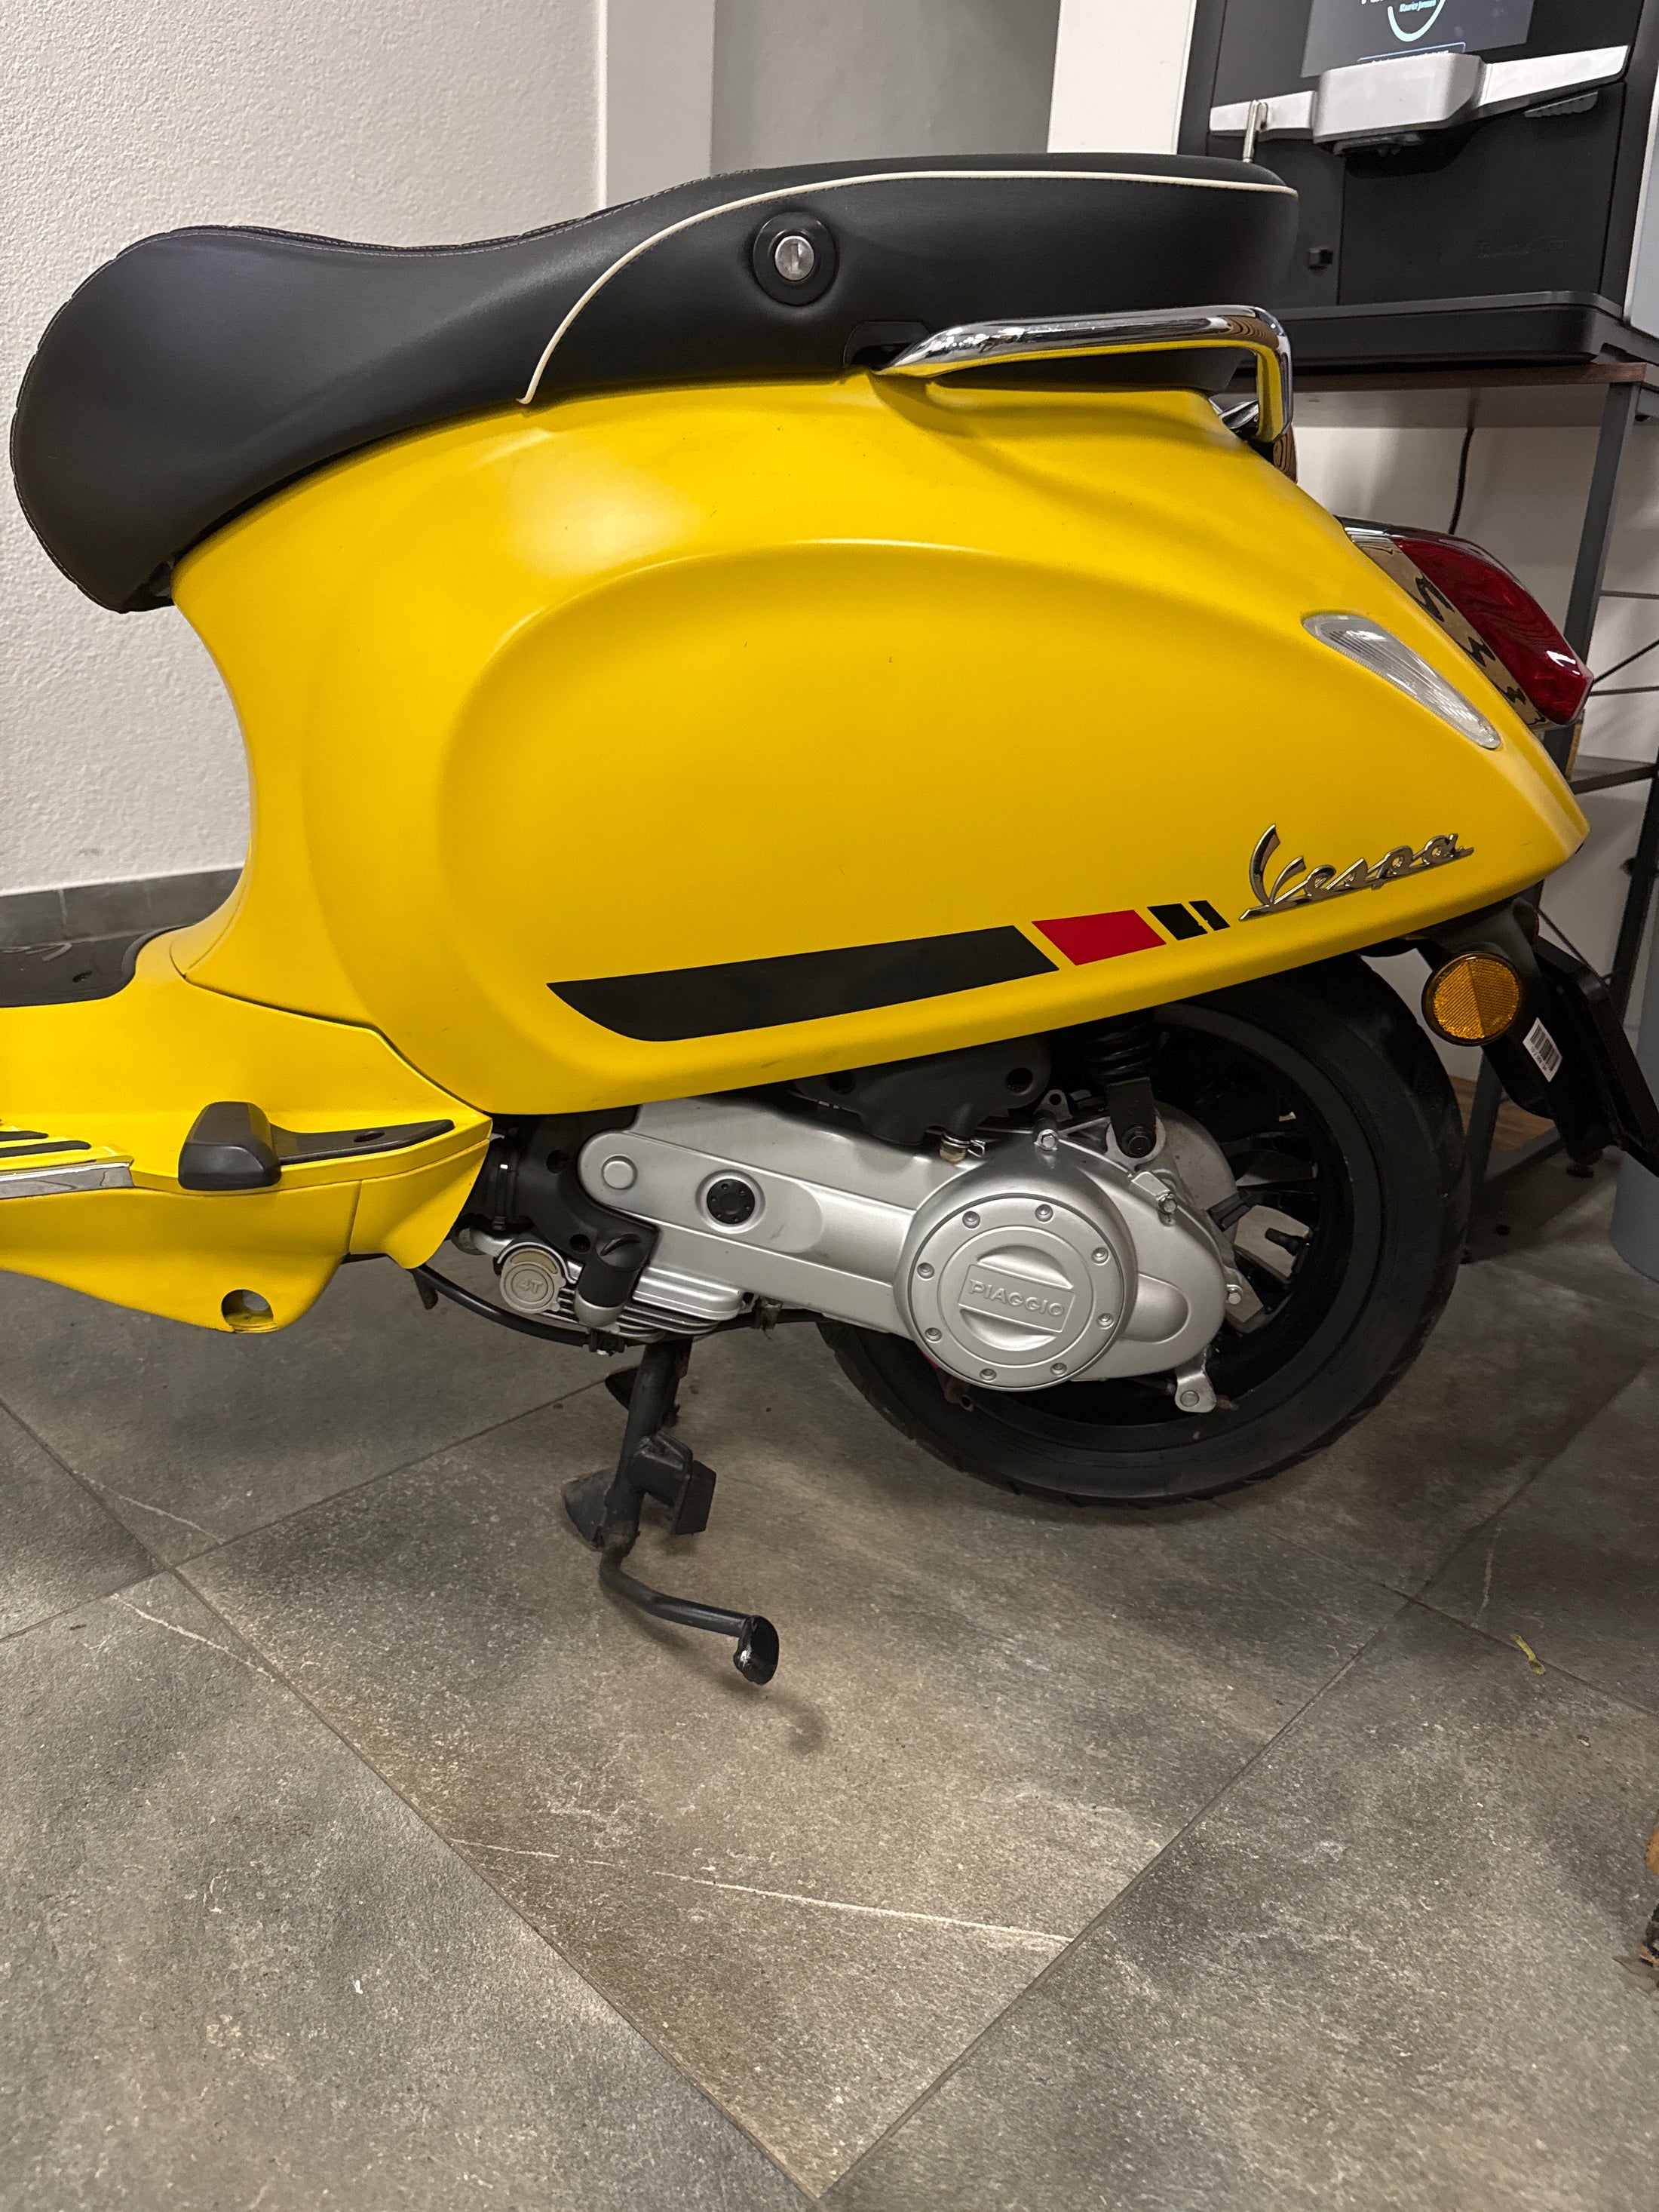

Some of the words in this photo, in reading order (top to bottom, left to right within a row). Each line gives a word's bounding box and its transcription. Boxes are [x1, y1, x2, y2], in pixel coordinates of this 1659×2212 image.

[1238, 824, 1474, 922] Vespa
[517, 1278, 544, 1294] 4T
[969, 1278, 1065, 1317] PIAGGIO
